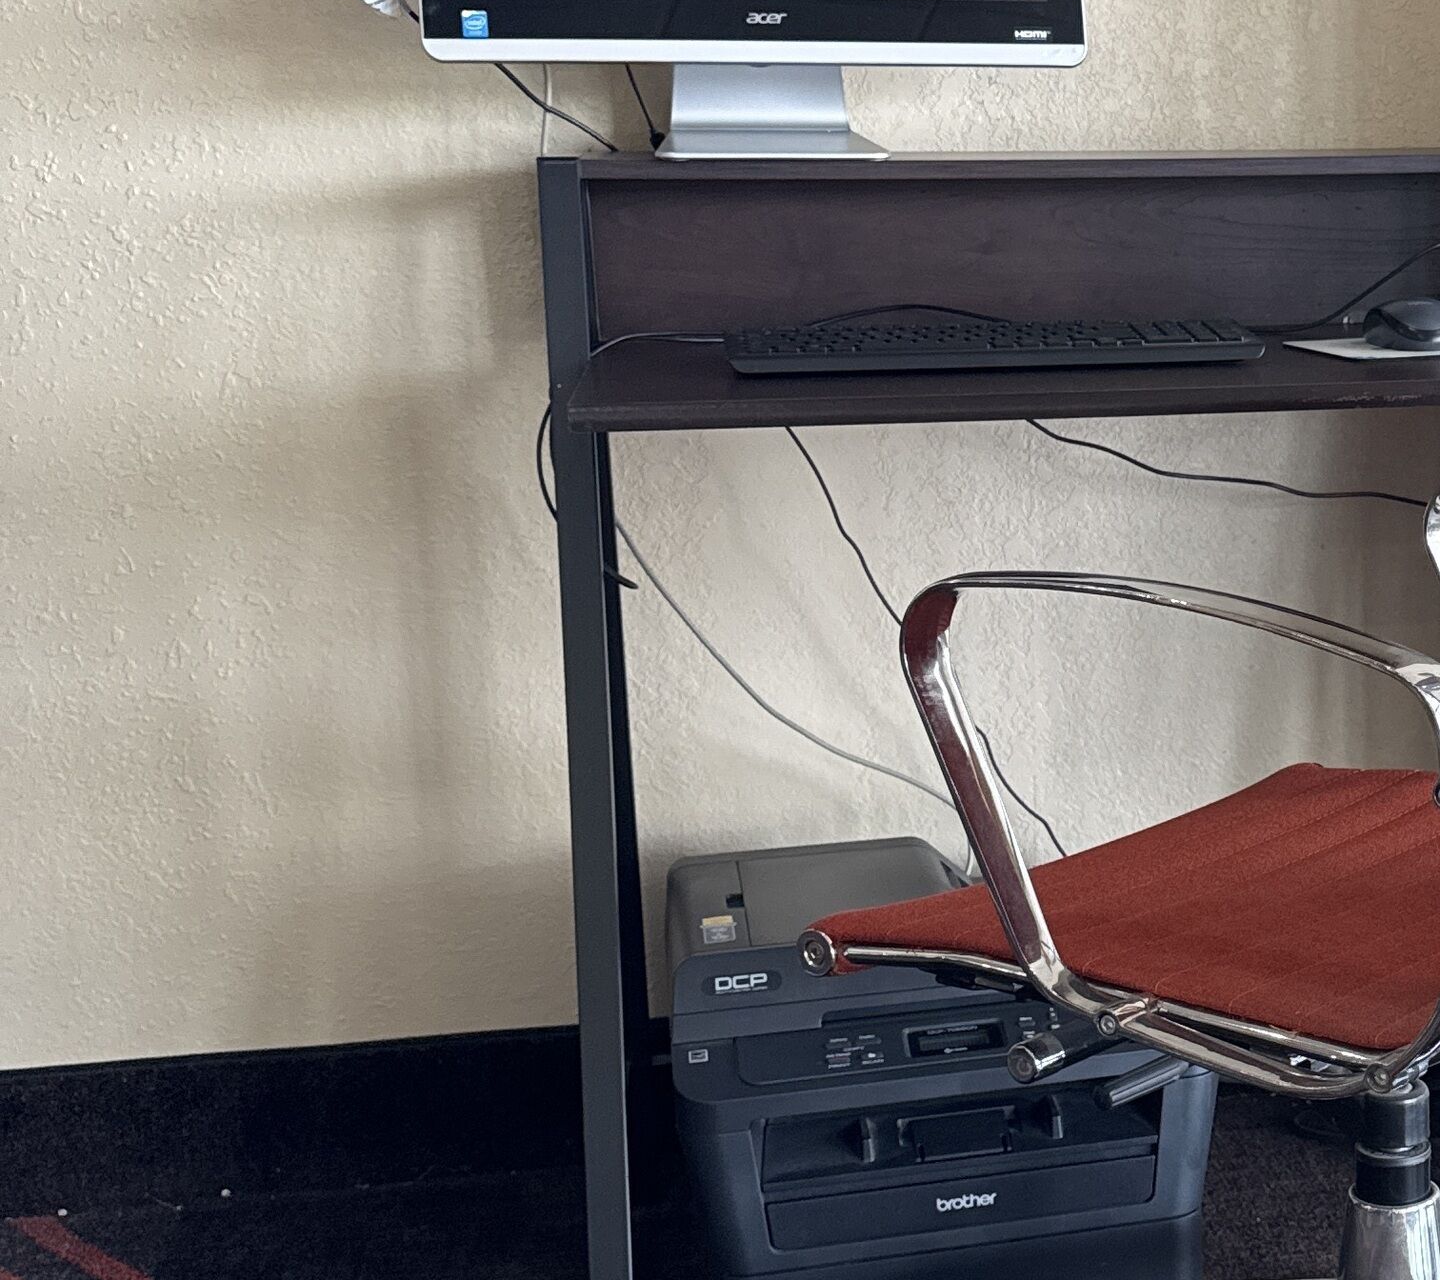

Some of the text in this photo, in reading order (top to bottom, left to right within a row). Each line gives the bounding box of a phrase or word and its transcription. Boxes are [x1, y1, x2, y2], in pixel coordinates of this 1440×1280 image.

[746, 12, 788, 25] acer
[1014, 30, 1048, 40] HDMI
[714, 972, 769, 991] DCP
[936, 1192, 997, 1212] brother
